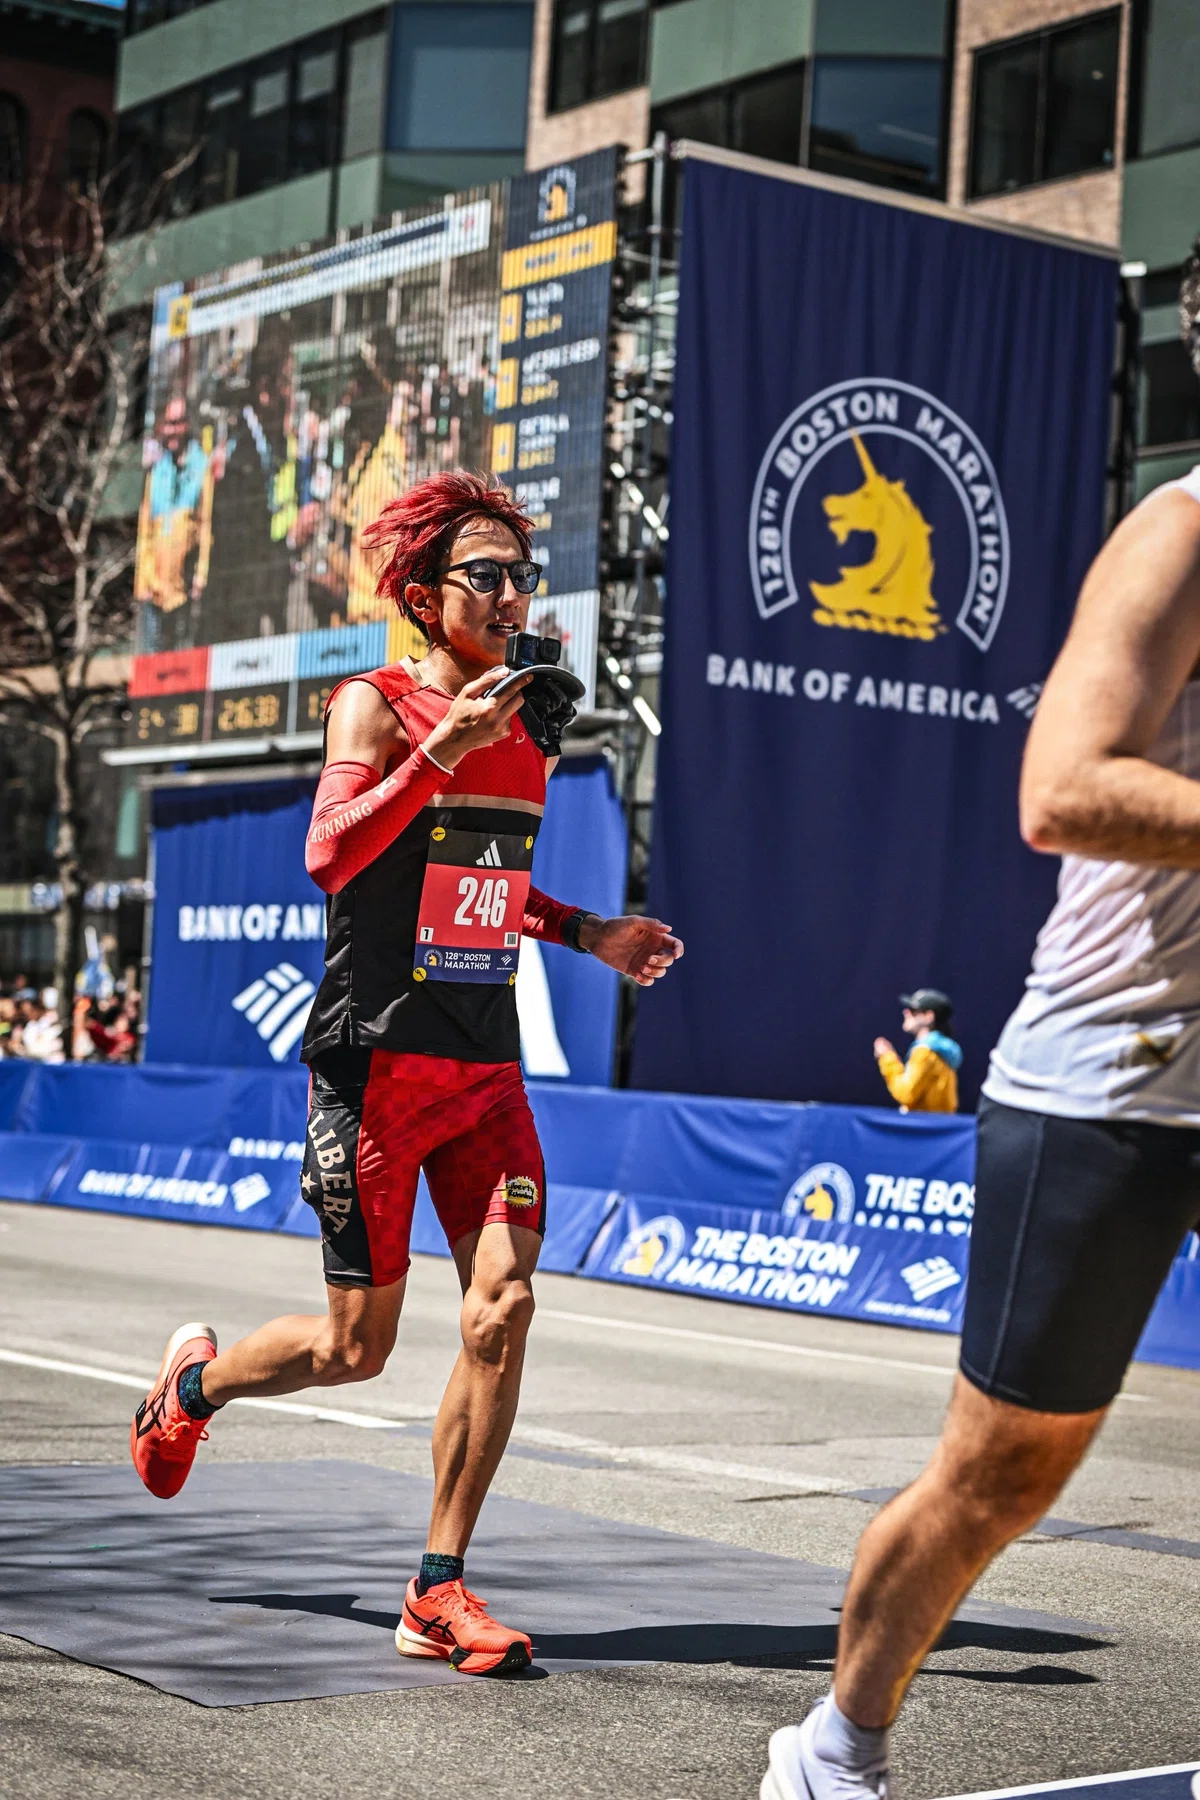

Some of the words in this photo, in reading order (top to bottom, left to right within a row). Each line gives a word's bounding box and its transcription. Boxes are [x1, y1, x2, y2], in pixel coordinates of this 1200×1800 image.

[775, 391, 898, 479] BOSTON
[916, 406, 1000, 623] MARATHON
[706, 653, 795, 696] BANK
[803, 668, 852, 702] OF
[855, 676, 1000, 724] AMERICA
[179, 905, 243, 941] BANK
[242, 904, 283, 941] OF
[281, 904, 328, 941] AM
[454, 876, 509, 928] 246
[424, 929, 430, 940] 1
[463, 953, 491, 961] BOSTON
[444, 960, 490, 970] MARATHON
[308, 1111, 353, 1243] LIBERT
[865, 1173, 926, 1213] THE
[690, 1226, 747, 1264] THE
[740, 1233, 860, 1277] BOSTON
[666, 1257, 842, 1307] MARATHON
